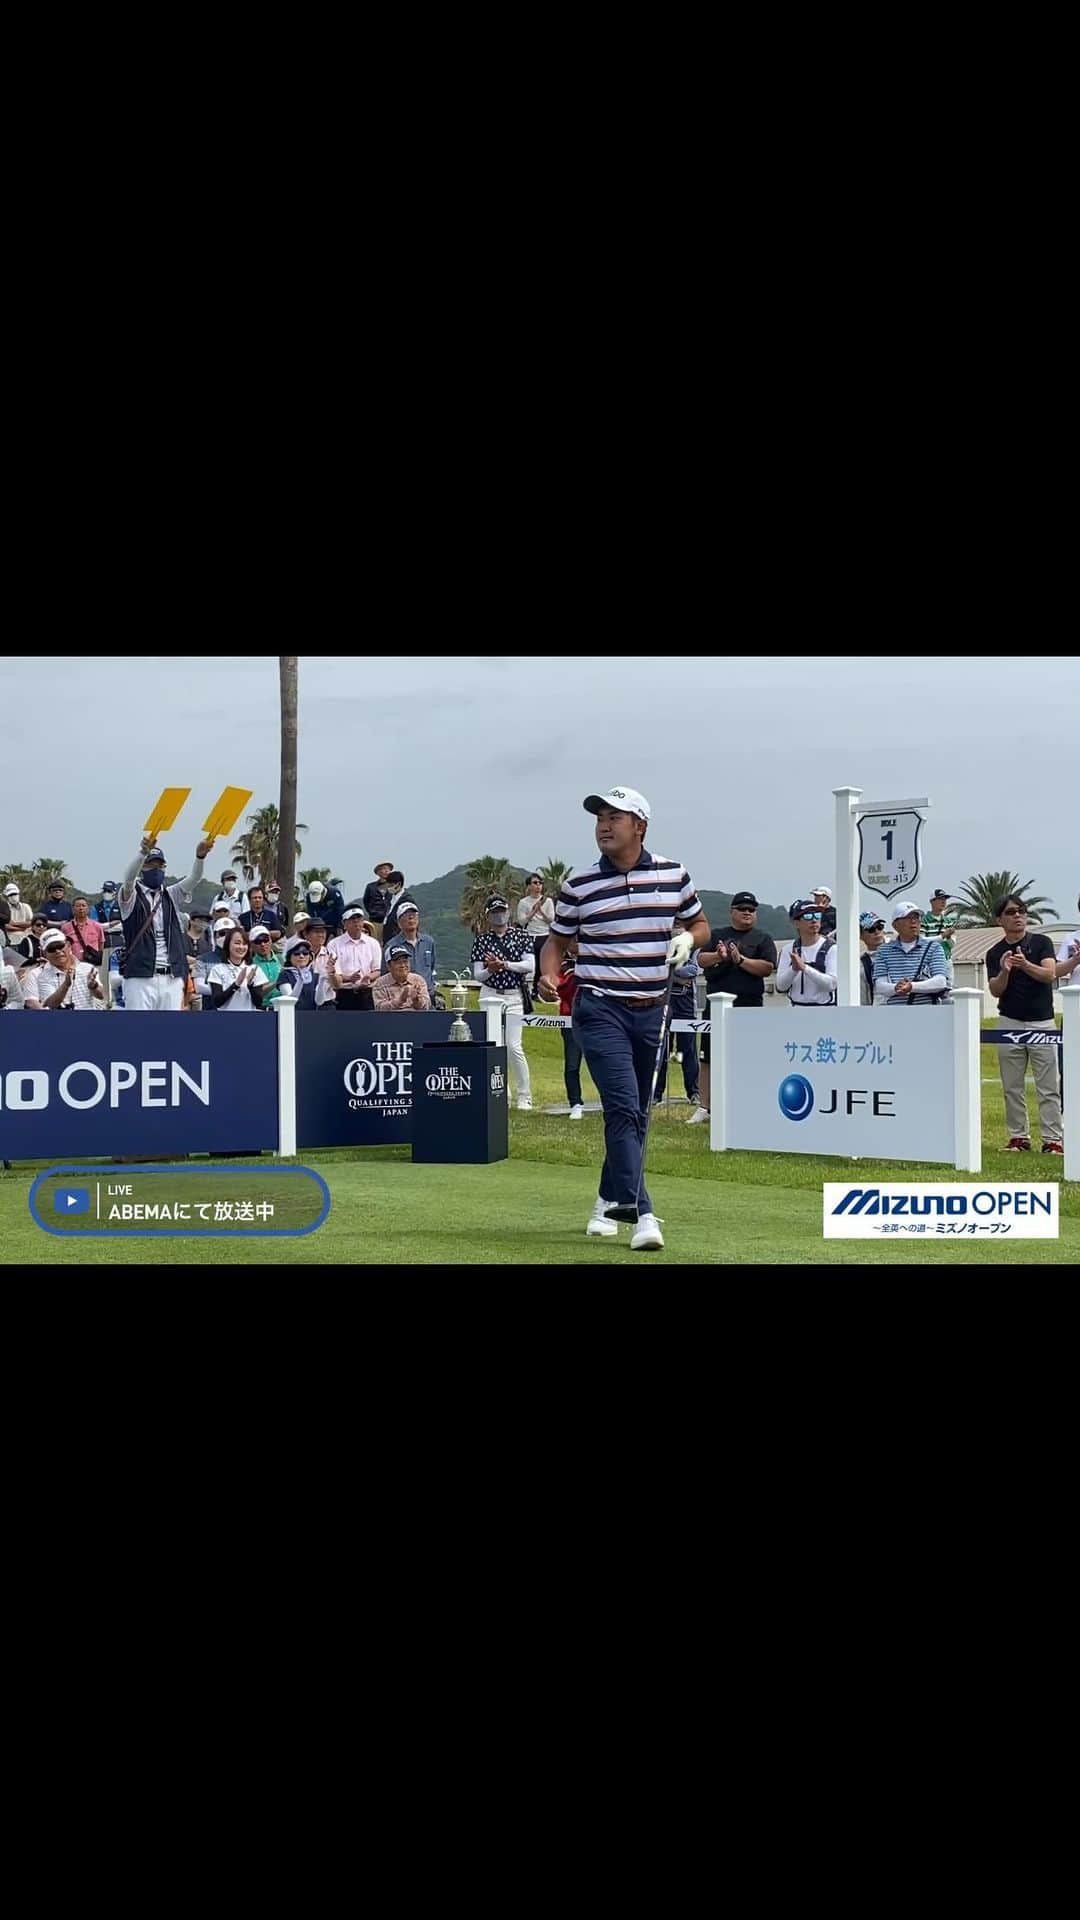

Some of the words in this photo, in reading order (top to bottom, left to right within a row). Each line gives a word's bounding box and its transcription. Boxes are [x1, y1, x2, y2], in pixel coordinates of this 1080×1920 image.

[881, 830, 893, 860] 1
[898, 860, 905, 873] 4
[893, 873, 908, 883] 415
[372, 1042, 413, 1061] THE
[438, 1066, 459, 1076] THE
[59, 1061, 210, 1110] OPEN
[425, 1073, 472, 1091] OPEN
[348, 1098, 405, 1110] QUALIFYING
[819, 1089, 896, 1117] JFE
[383, 1108, 408, 1118] JAPAN
